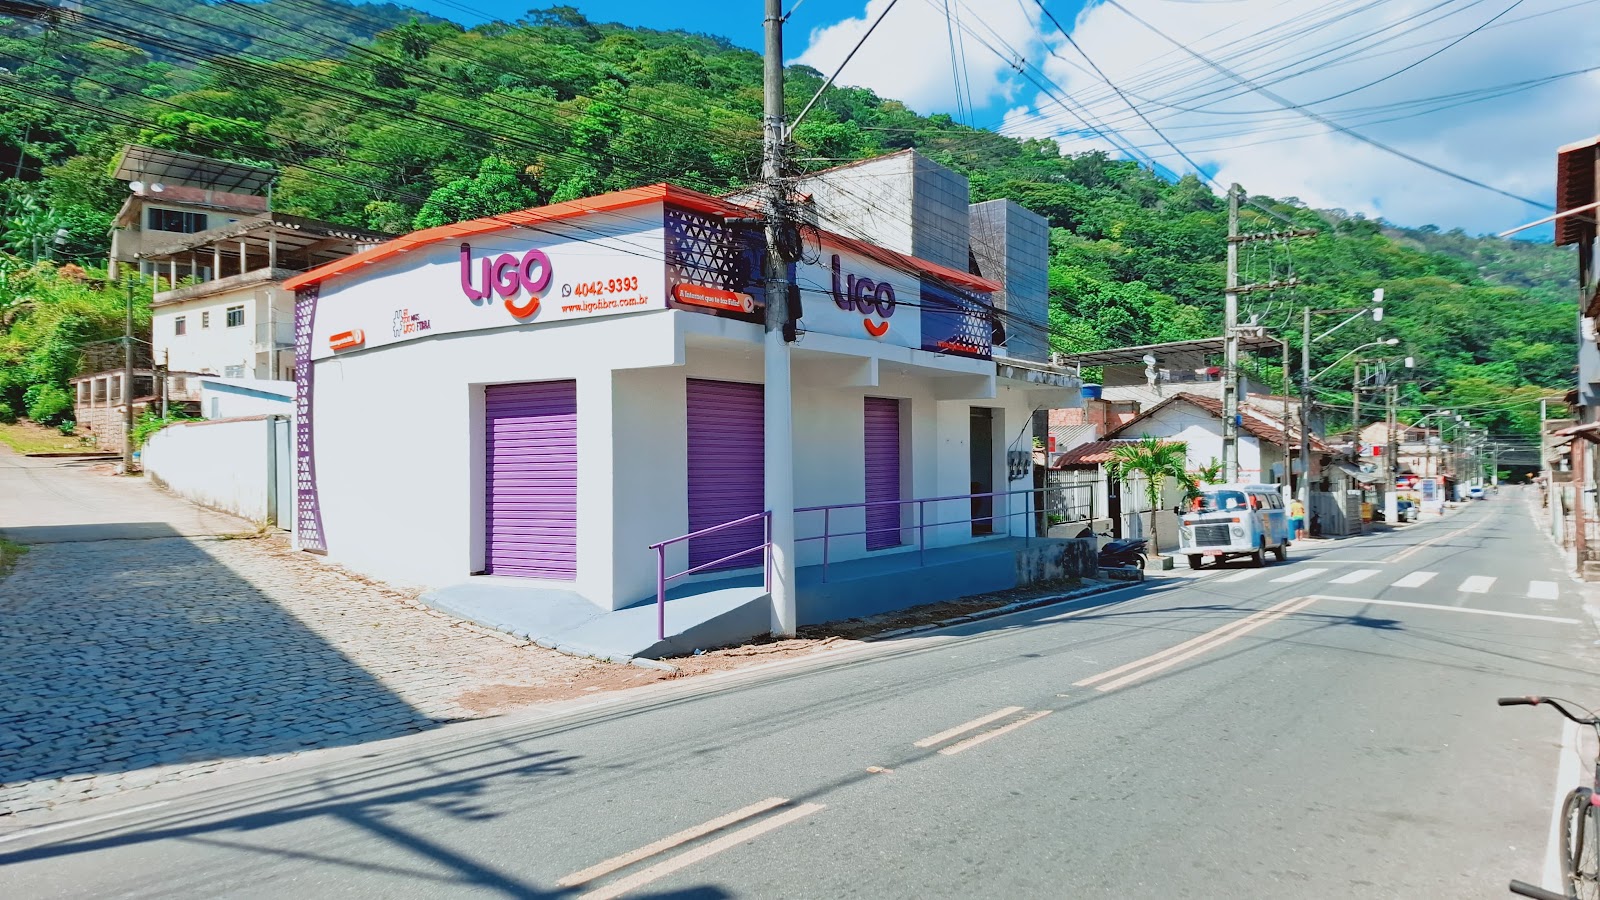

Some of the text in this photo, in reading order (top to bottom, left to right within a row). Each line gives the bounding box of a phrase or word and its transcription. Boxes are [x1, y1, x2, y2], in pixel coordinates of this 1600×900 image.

[460, 242, 553, 299] LIGO
[574, 276, 638, 298] 4042-9393
[685, 291, 704, 301] Internet
[832, 254, 895, 318] LIGO
[561, 294, 648, 314] www.ligofibra.com.br
